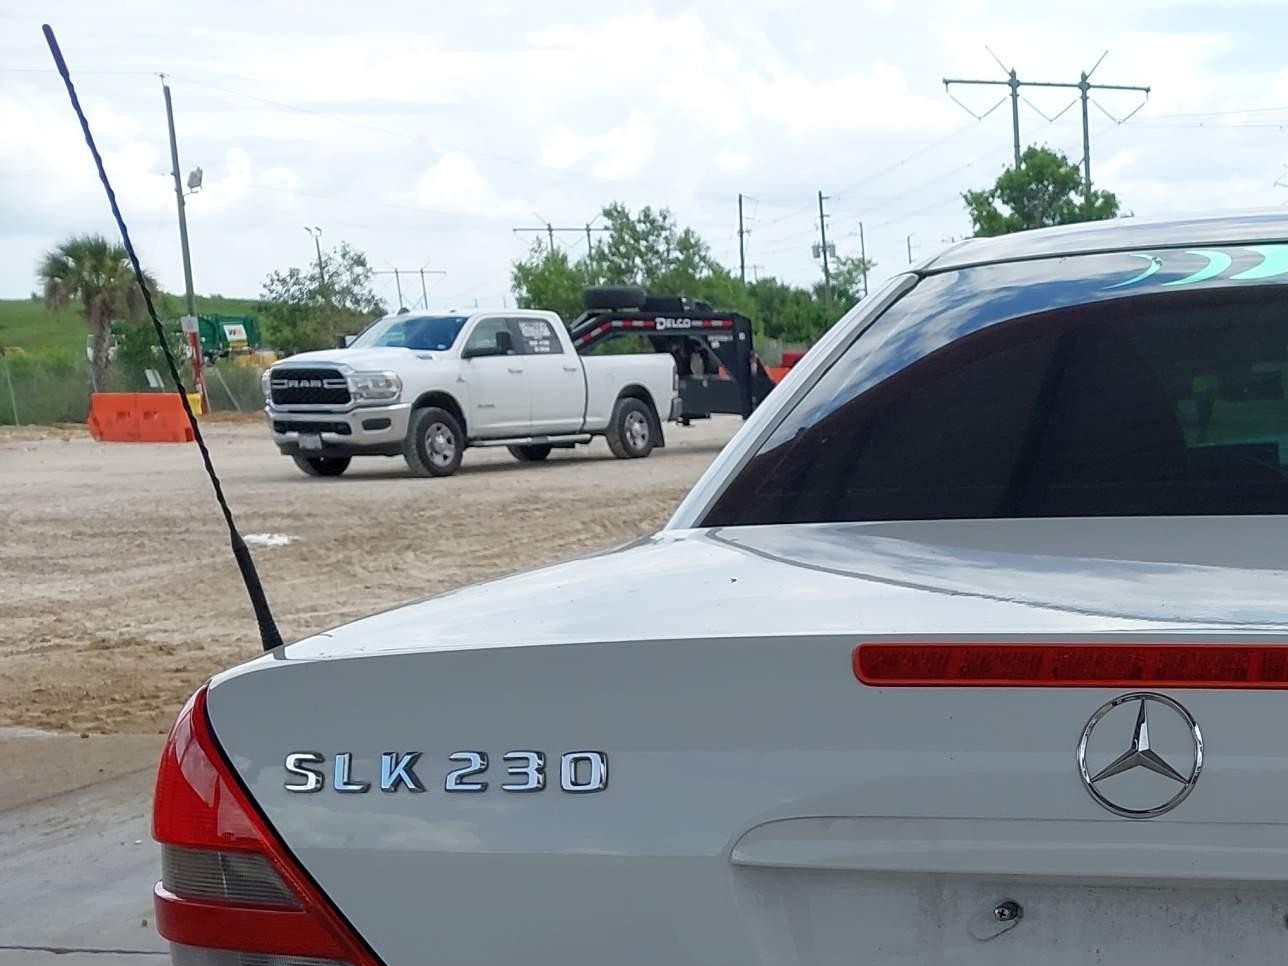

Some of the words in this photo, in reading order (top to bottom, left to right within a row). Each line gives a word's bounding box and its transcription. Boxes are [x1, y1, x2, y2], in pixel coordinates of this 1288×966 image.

[655, 317, 691, 330] DELCO
[288, 379, 322, 388] RAM
[283, 751, 427, 793] SLK
[444, 751, 610, 793] 230
